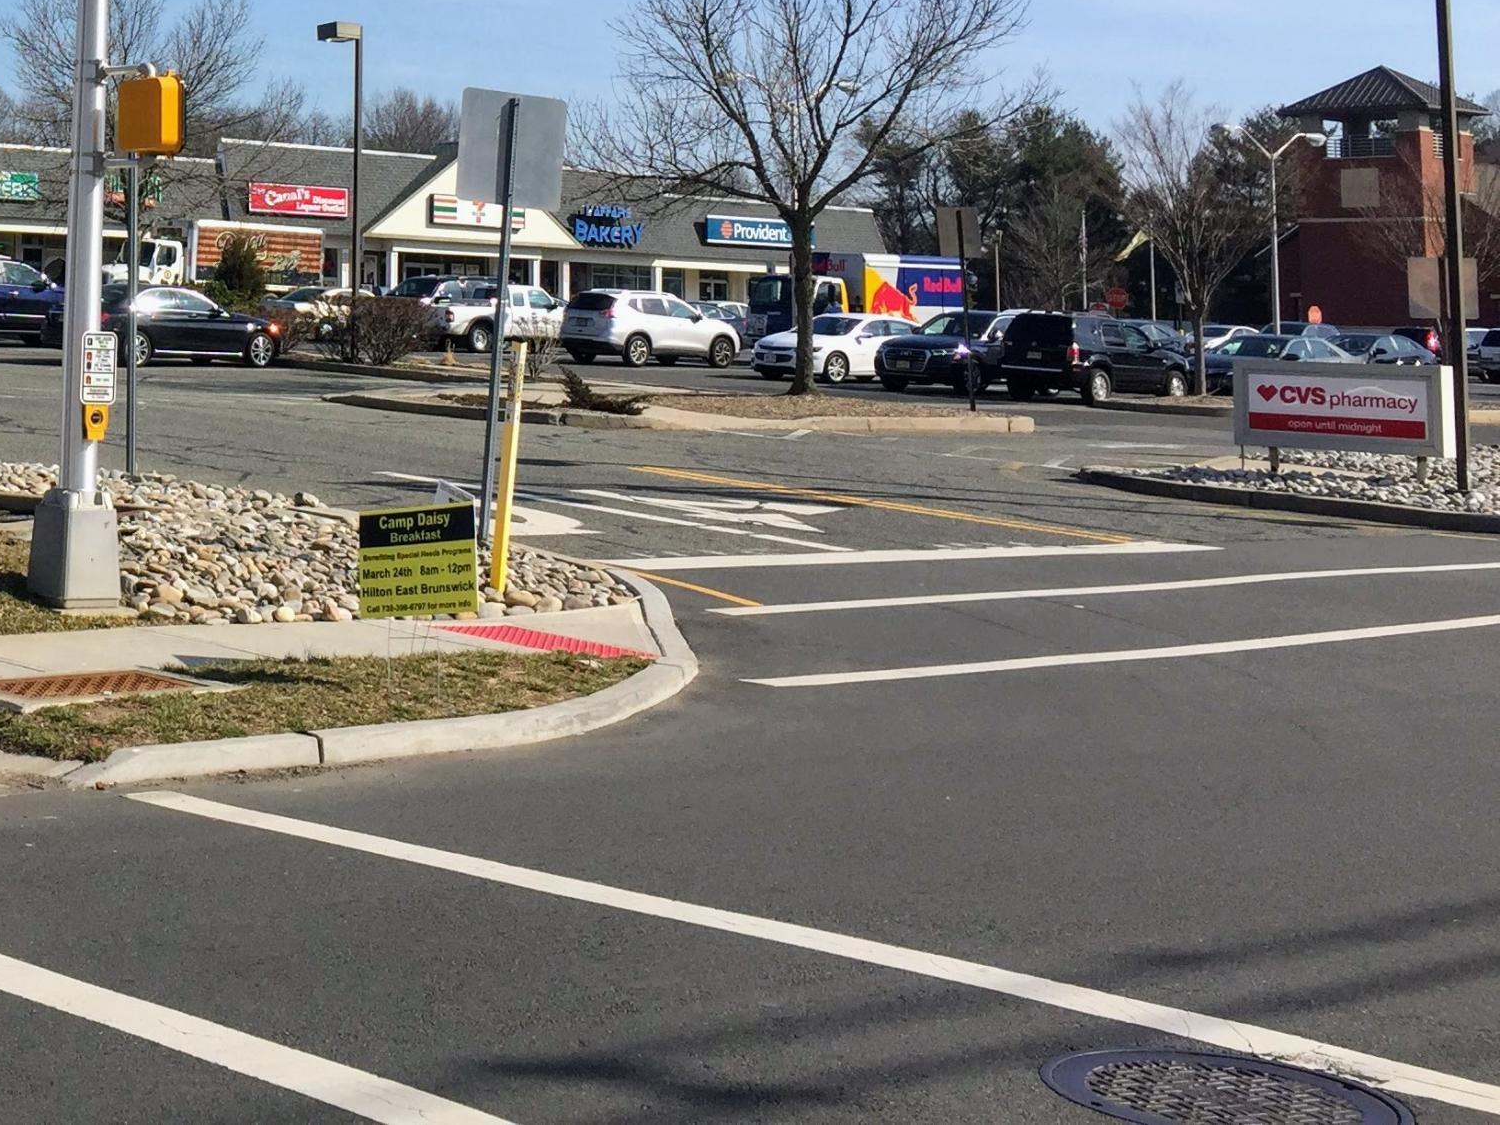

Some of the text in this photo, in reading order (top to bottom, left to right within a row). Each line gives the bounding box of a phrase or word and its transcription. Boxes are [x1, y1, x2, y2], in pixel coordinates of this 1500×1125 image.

[575, 218, 644, 244] BAKERY
[733, 223, 788, 242] Provident
[1279, 385, 1419, 413] CVS pharmacy
[1287, 419, 1382, 434] open until midnight
[378, 512, 451, 531] Camp Daisy
[389, 530, 441, 543] Breakfast
[362, 568, 391, 579] March
[393, 567, 413, 578] 24th
[419, 565, 439, 576] 8am
[447, 562, 472, 574] 12pm
[362, 580, 475, 598] Hilton East Brunswick
